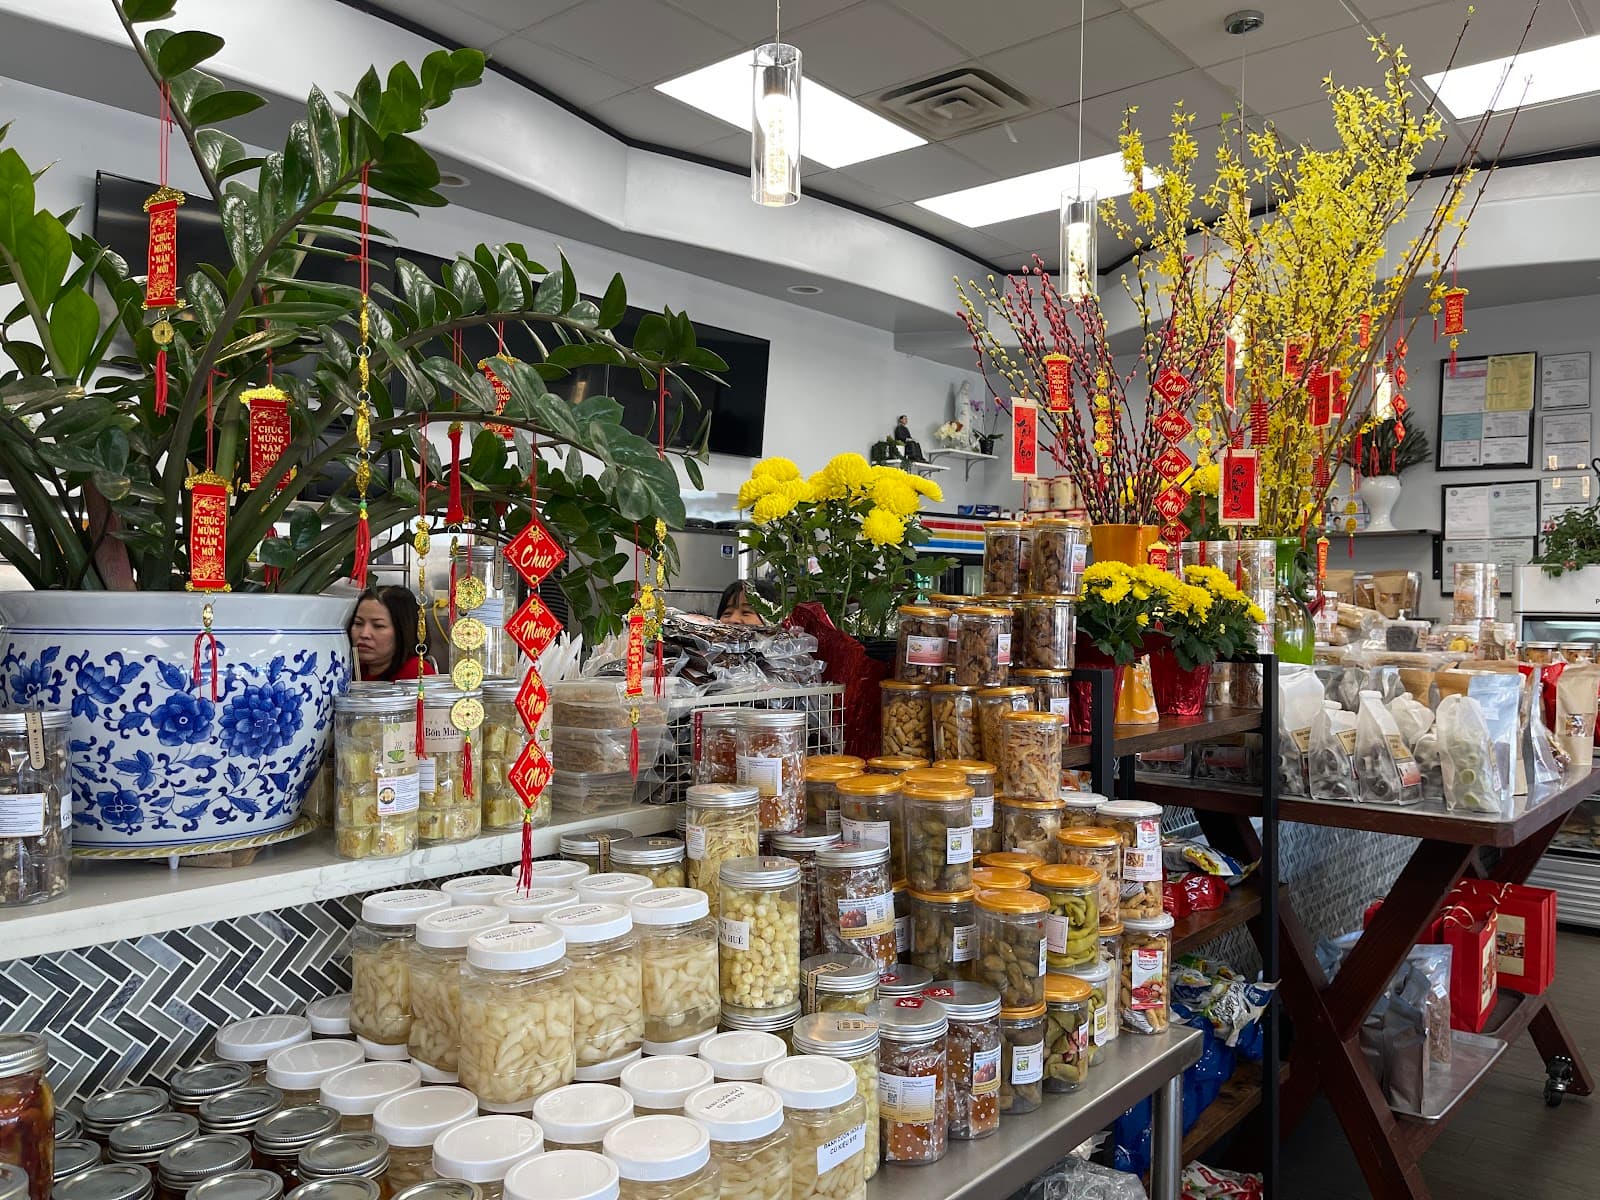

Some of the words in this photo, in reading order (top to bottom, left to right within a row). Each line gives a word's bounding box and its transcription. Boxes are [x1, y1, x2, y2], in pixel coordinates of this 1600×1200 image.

[1165, 379, 1185, 392] Chúc
[258, 423, 284, 434] CHÚC
[257, 433, 285, 443] MỪNG
[260, 443, 282, 452] NĂM
[262, 451, 280, 462] MỚI
[1162, 460, 1180, 473] Năm
[1163, 500, 1179, 514] Mới
[198, 513, 220, 525] CHÚC
[197, 524, 220, 535] MỪNG
[200, 535, 218, 546] NĂM
[201, 545, 216, 557] MỚI
[520, 544, 553, 569] Chúc
[520, 620, 552, 645] Mừng
[525, 767, 547, 790] Mới
